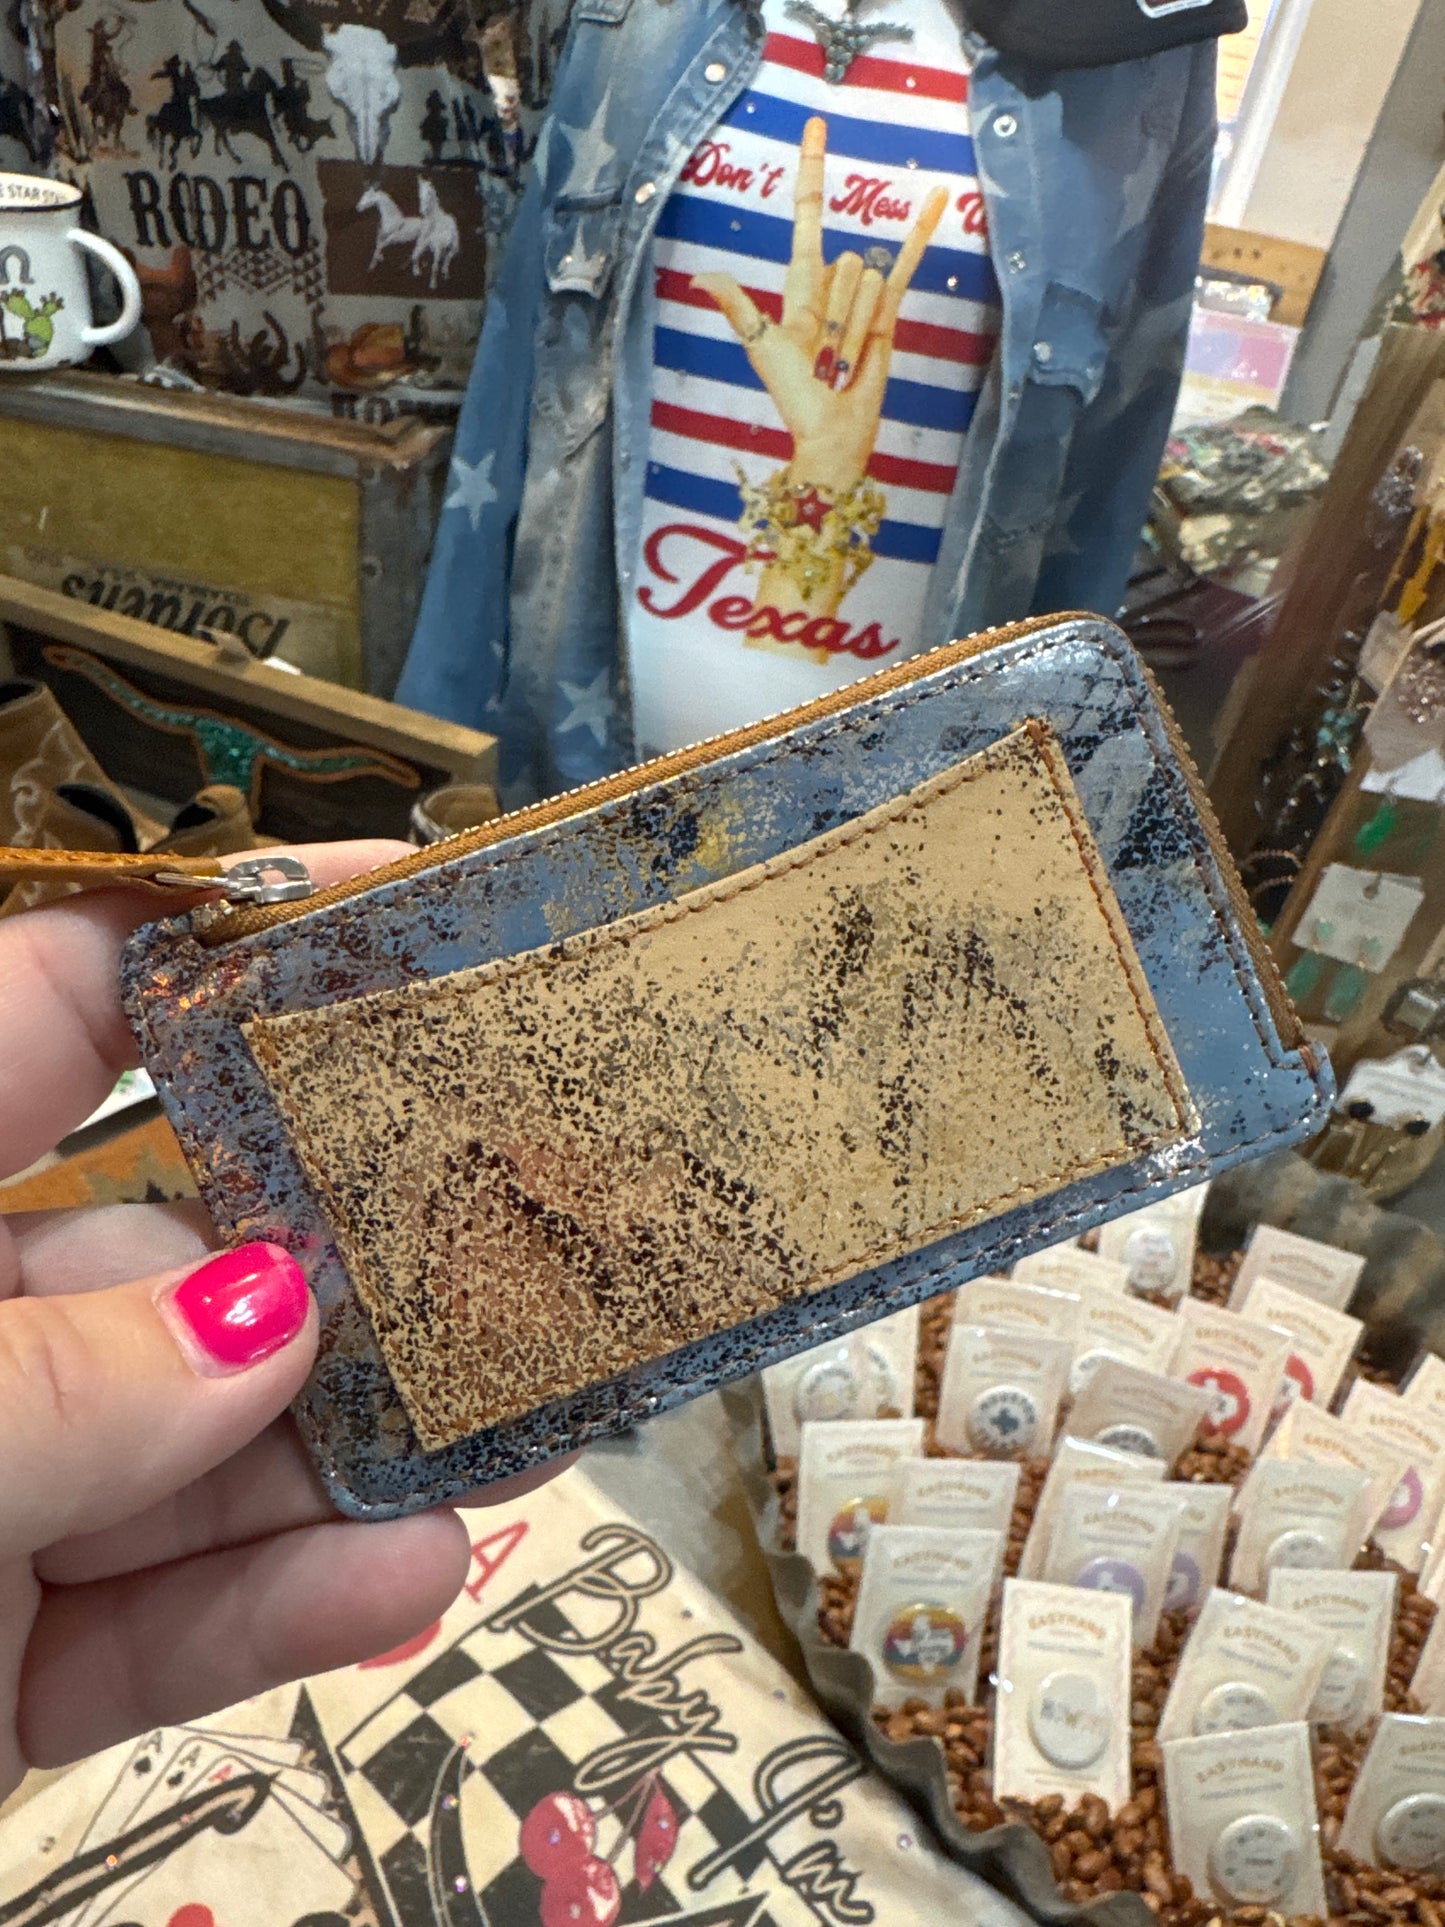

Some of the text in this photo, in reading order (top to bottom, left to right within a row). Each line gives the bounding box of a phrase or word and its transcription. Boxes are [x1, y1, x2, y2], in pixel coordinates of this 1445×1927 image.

[122, 170, 311, 258] RODEO
[679, 139, 785, 199] Don't
[829, 174, 911, 226] Mess
[637, 523, 899, 660] Texas
[486, 1523, 743, 1793] Baby
